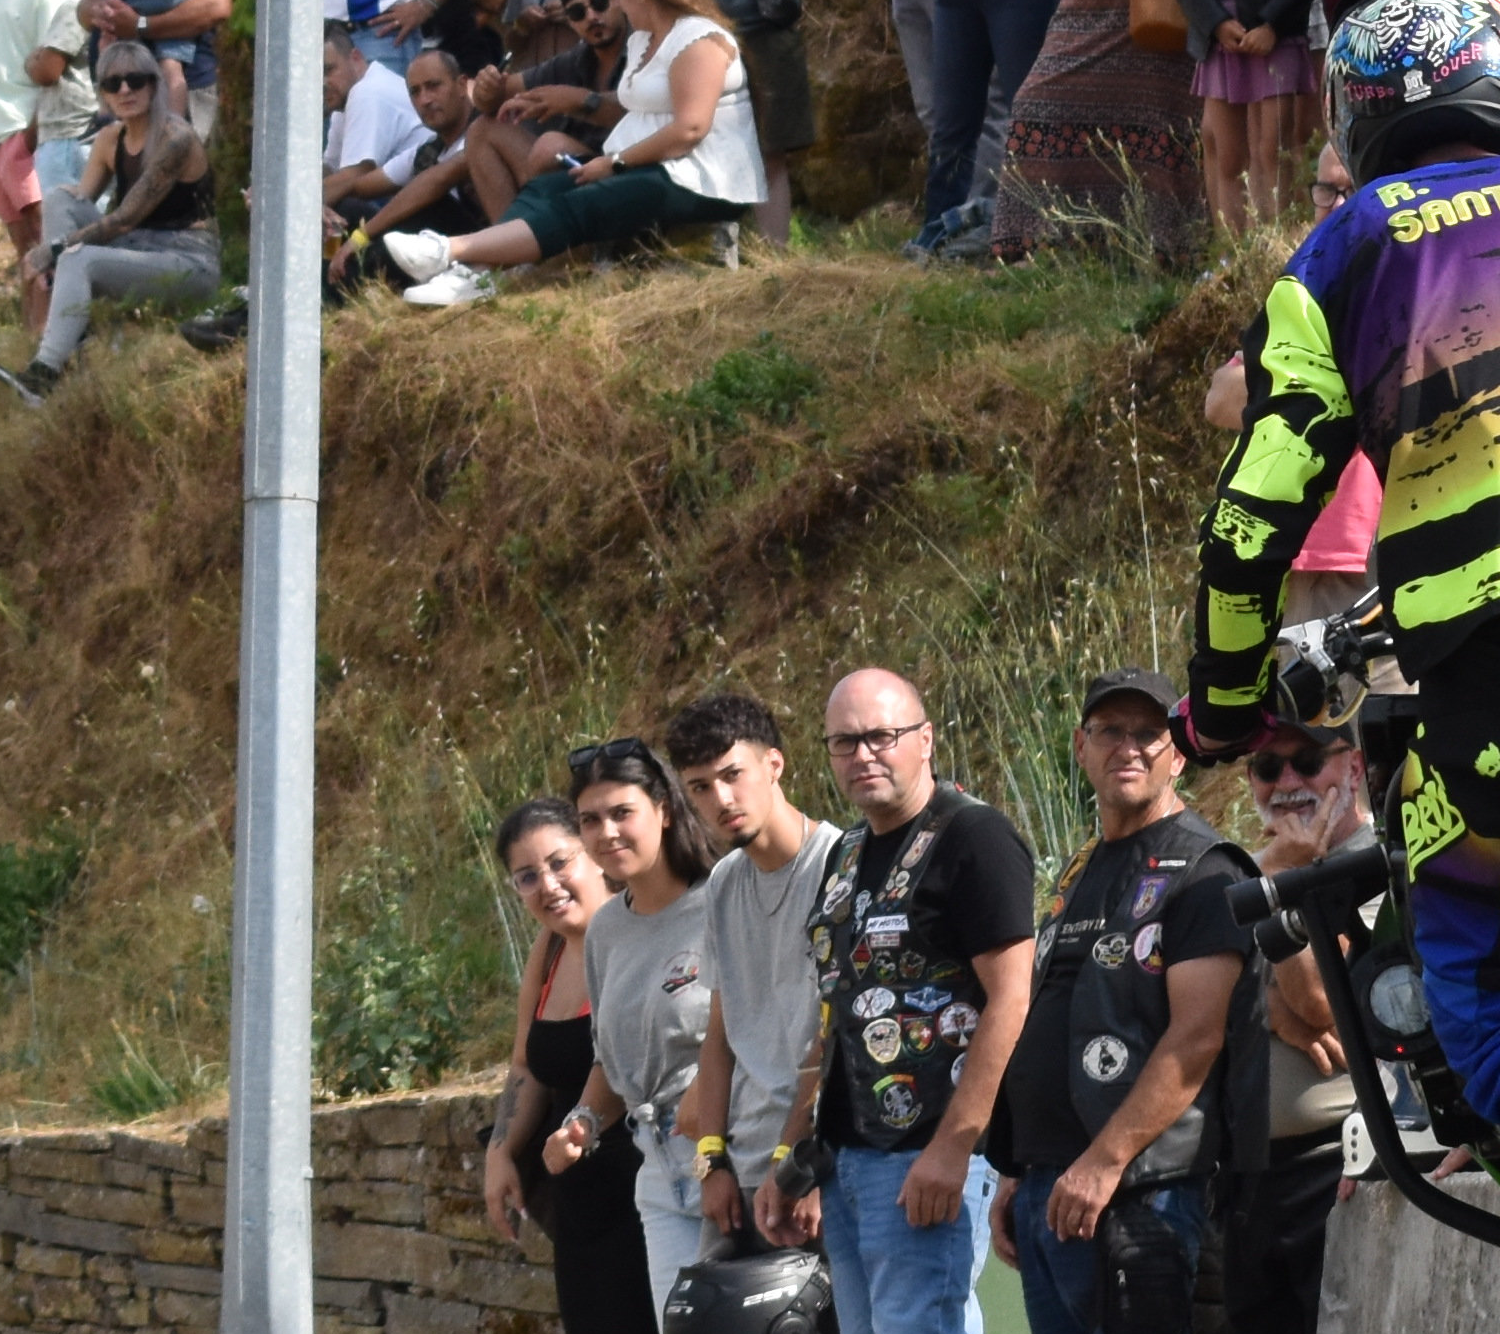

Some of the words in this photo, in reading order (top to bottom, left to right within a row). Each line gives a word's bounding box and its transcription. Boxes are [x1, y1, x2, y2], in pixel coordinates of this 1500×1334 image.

[1432, 41, 1484, 83] LOVER
[1404, 70, 1425, 90] DOT
[1376, 181, 1431, 208] R.
